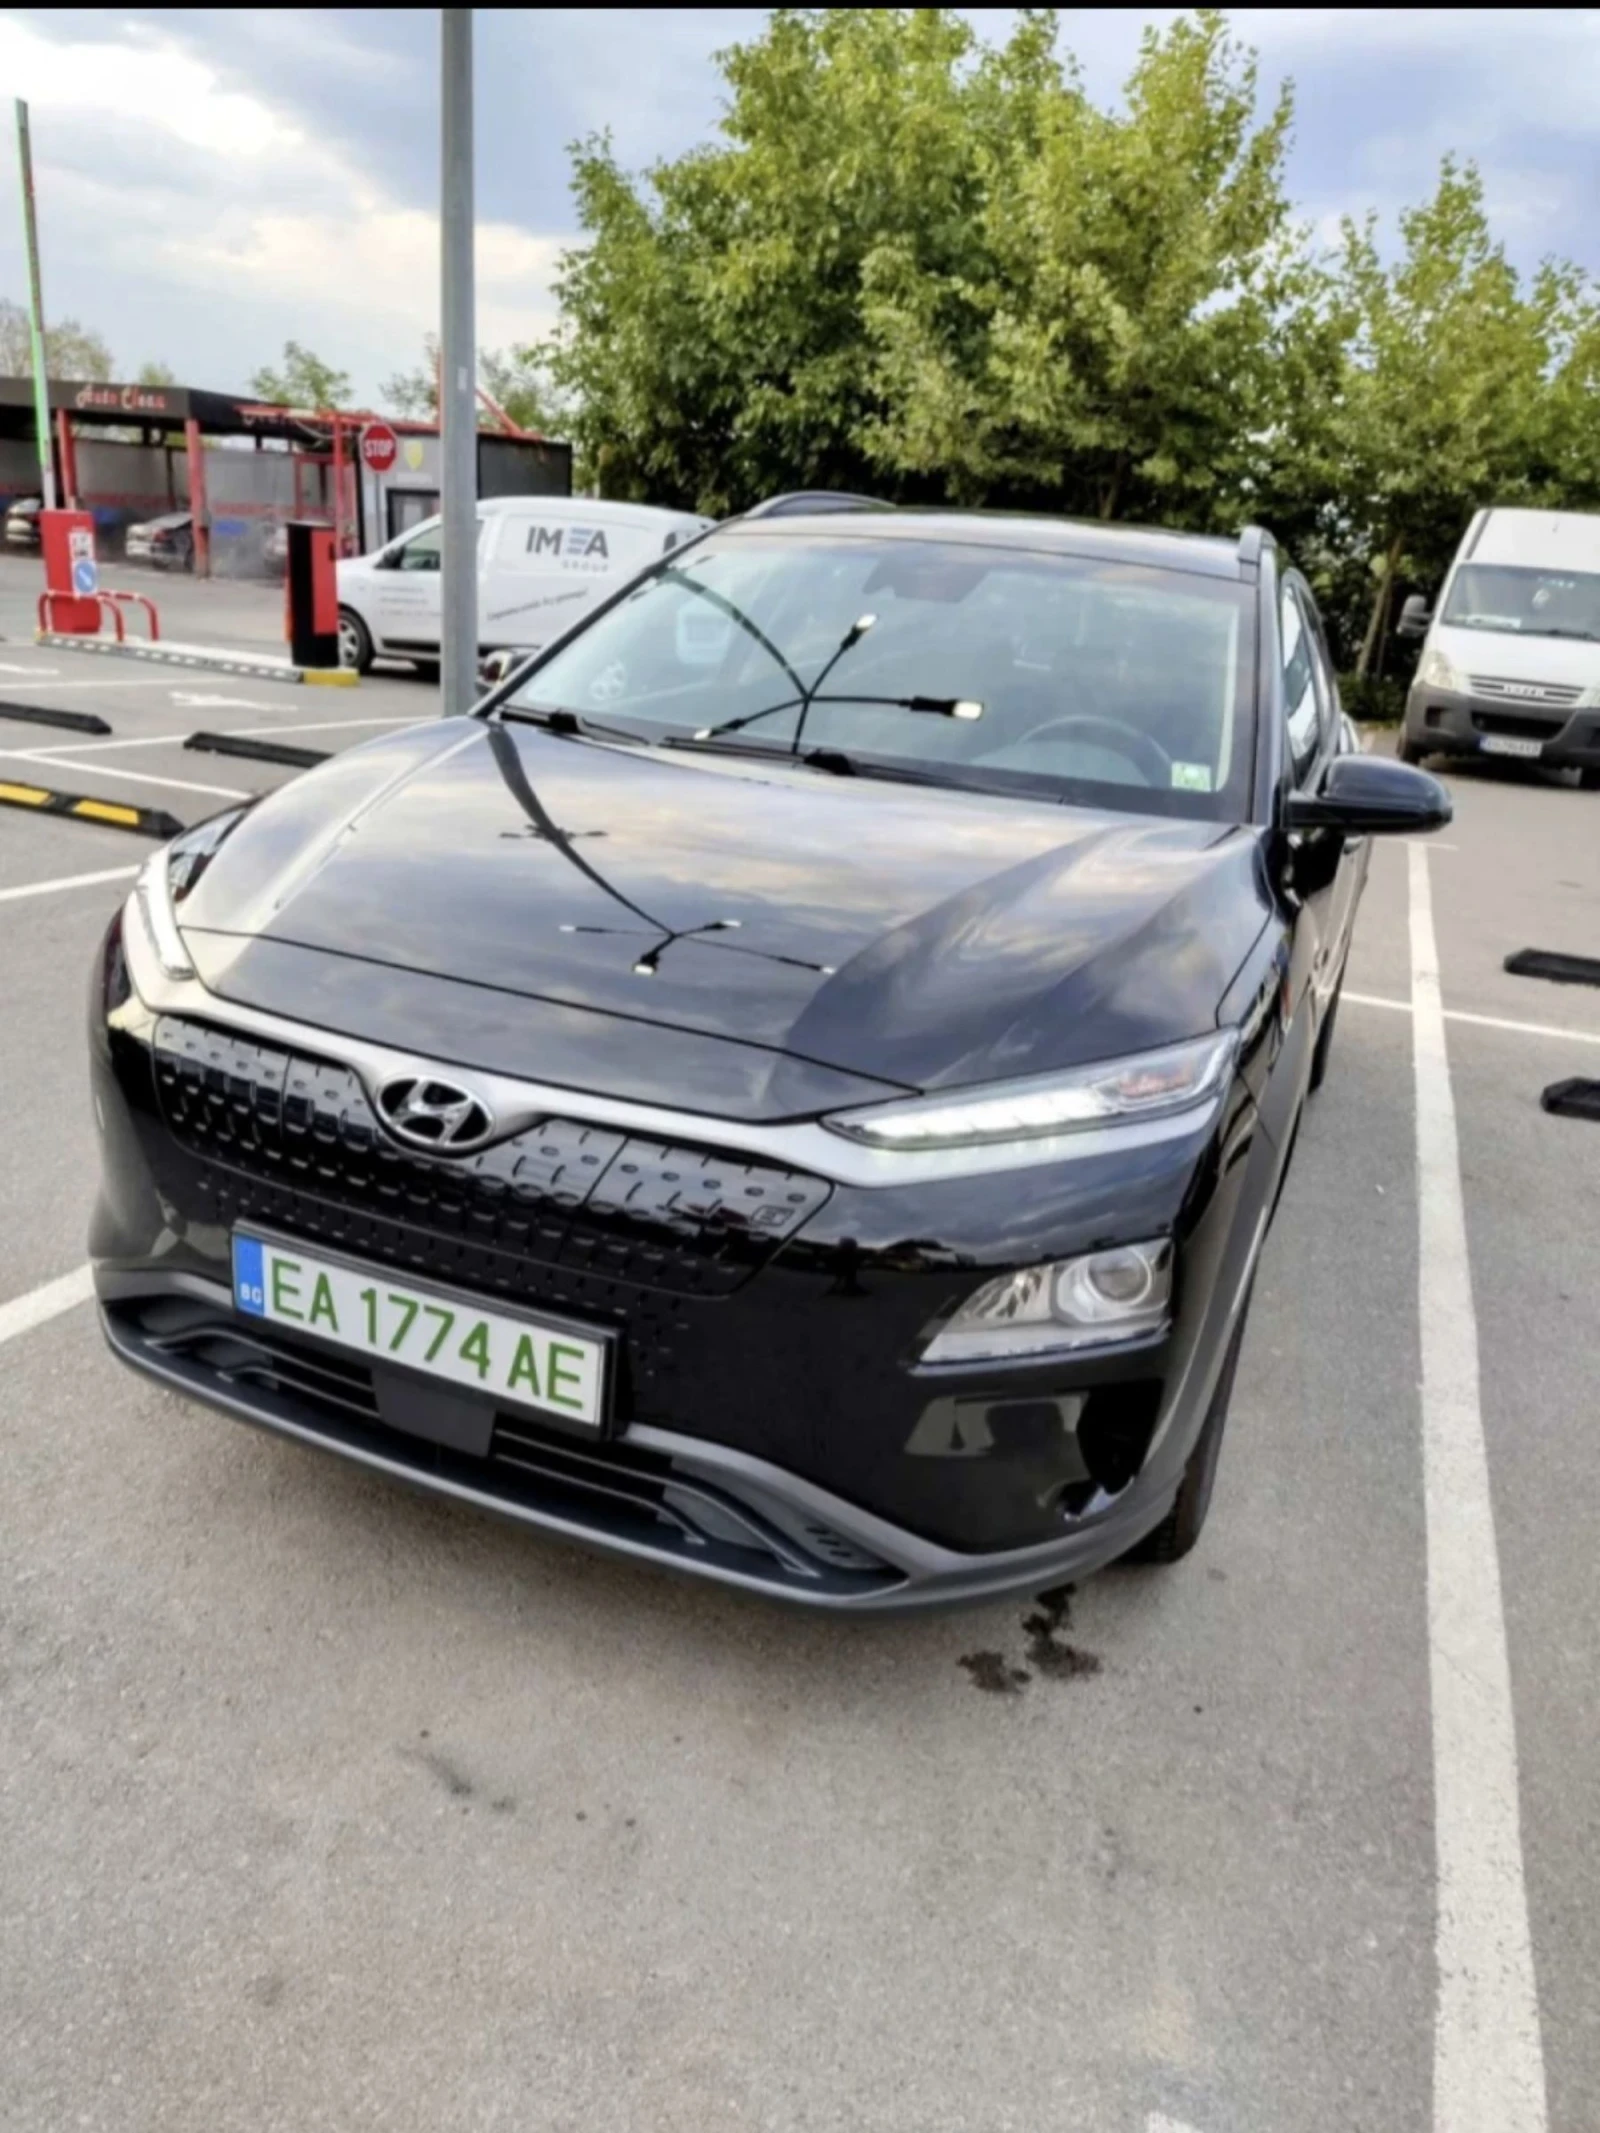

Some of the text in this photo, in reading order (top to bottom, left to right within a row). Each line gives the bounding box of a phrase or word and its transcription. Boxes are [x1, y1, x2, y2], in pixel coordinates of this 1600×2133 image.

[364, 439, 394, 458] STOP
[526, 526, 608, 558] IMEA
[240, 1283, 262, 1304] BG
[271, 1257, 586, 1410] EA 1774 AE
